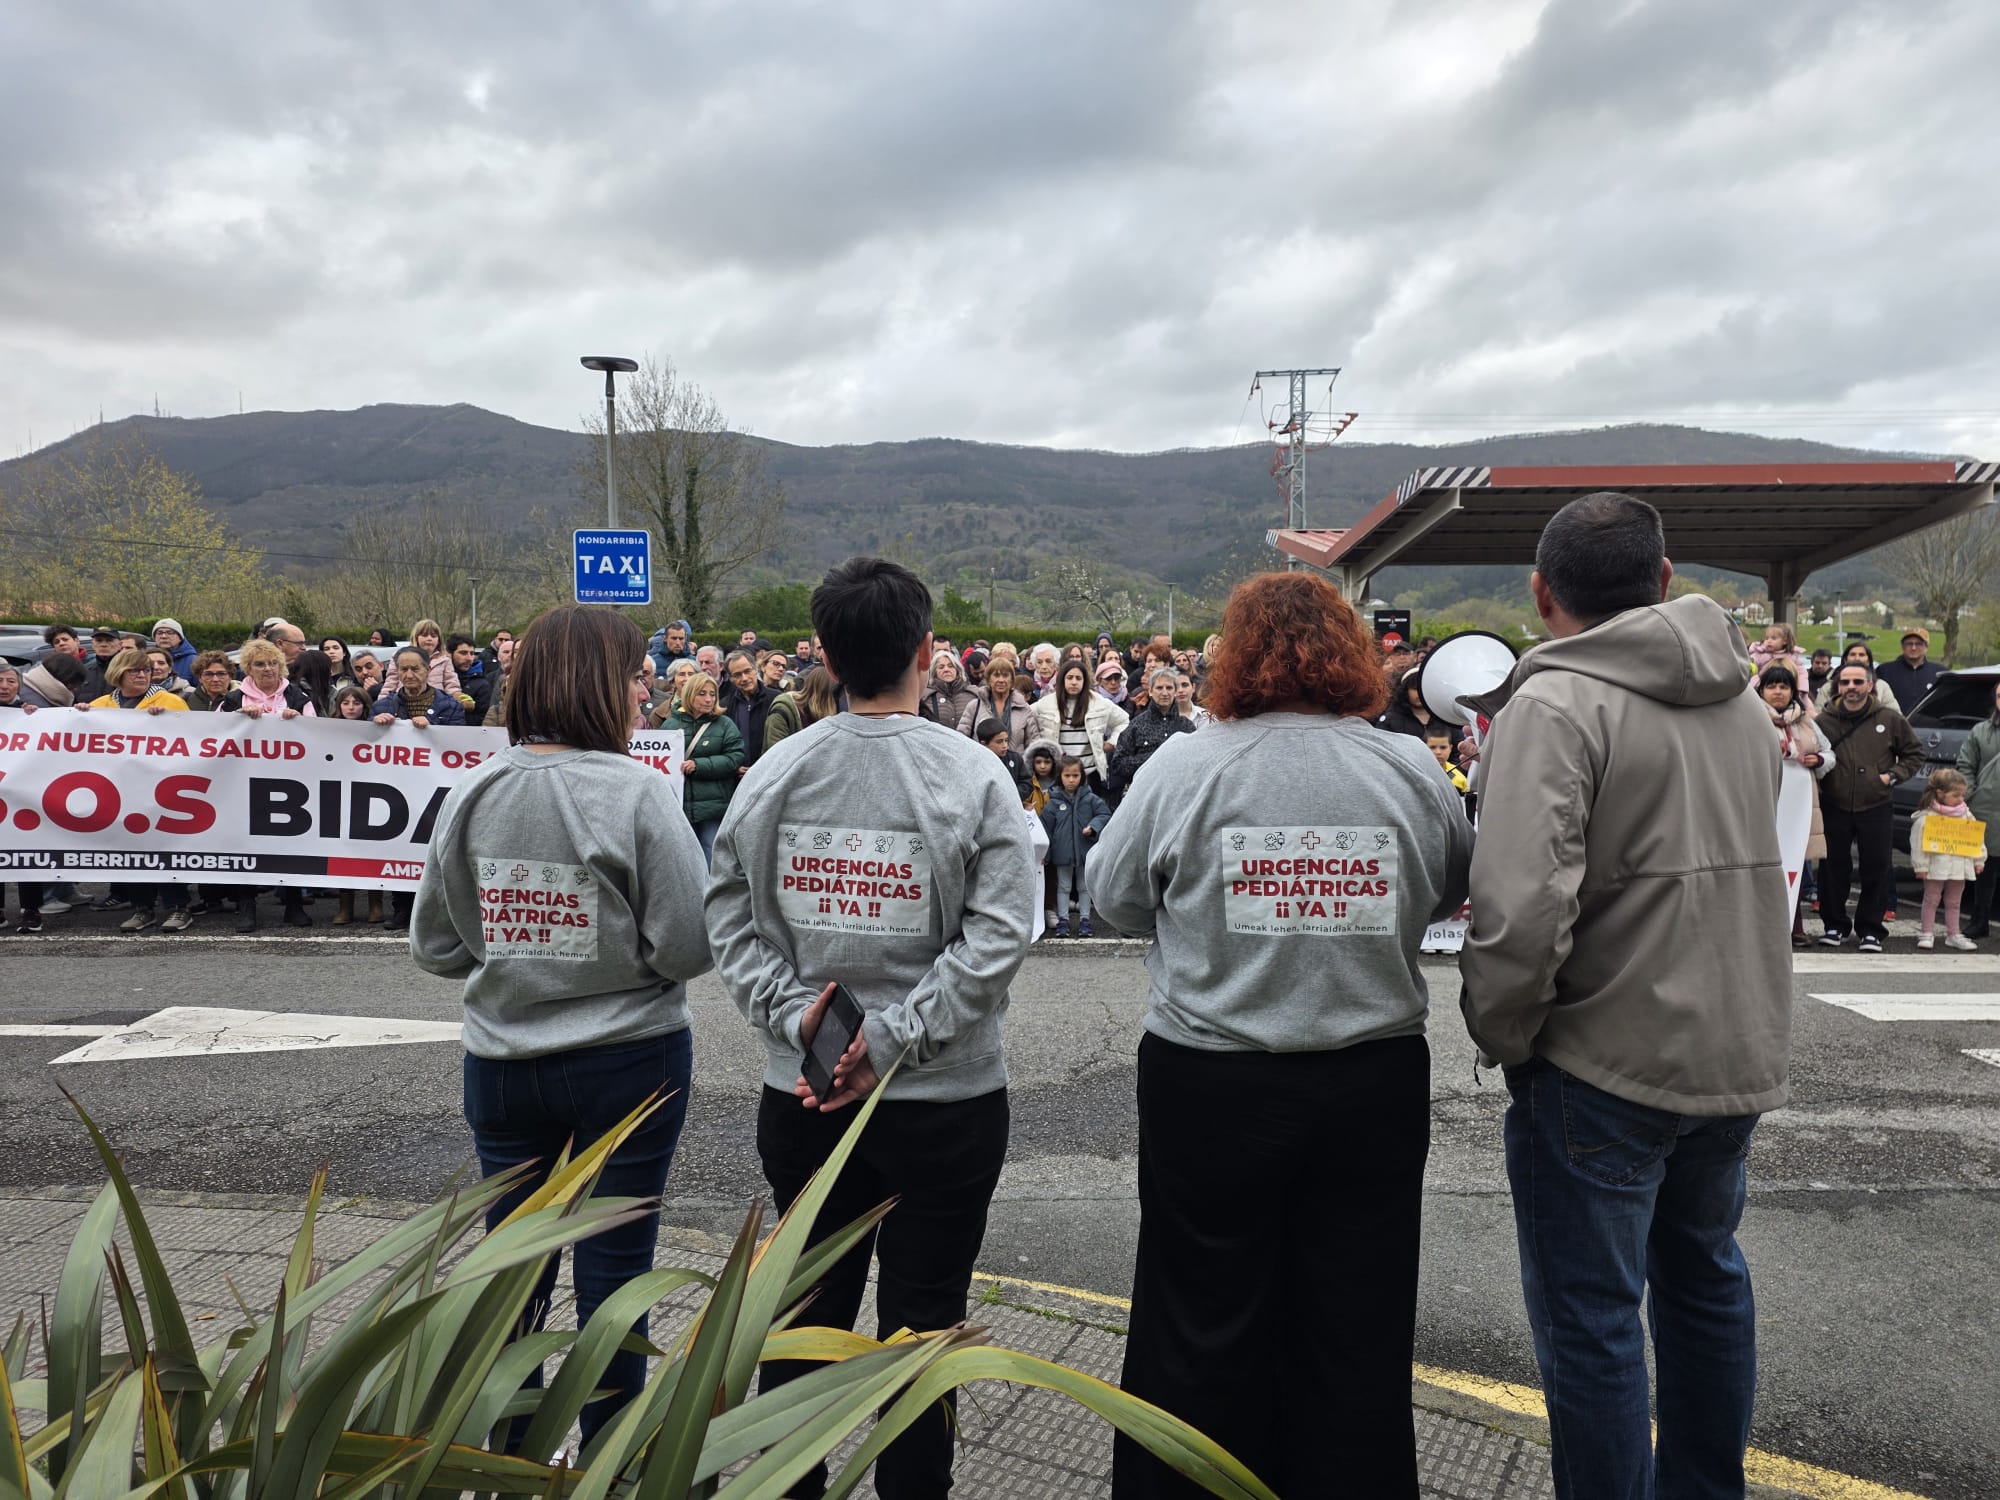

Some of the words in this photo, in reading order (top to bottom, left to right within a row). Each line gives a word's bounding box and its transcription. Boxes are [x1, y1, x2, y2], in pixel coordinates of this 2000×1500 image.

[578, 536, 645, 545] HONDARRIBIA
[579, 555, 644, 574] TAXI
[37, 732, 190, 757] NUESTRA
[199, 737, 306, 761] SALUD
[352, 743, 431, 767] GURE
[441, 750, 496, 769] OS
[0, 770, 216, 834] .O.S
[64, 853, 165, 870] BERRITU,
[171, 854, 257, 870] HOBETU
[791, 856, 913, 880] URGENCIAS
[1241, 858, 1379, 876] URGENCIAS
[783, 875, 922, 900] PEDIÁTRICAS
[1232, 876, 1388, 897] PEDIÁTRICAS
[478, 887, 579, 909] RGENCIAS
[837, 898, 861, 917] YA
[868, 902, 881, 918] !!
[1295, 901, 1327, 918] YA
[1333, 901, 1347, 918] !!
[501, 927, 532, 943] YA
[538, 928, 551, 944] !!
[813, 919, 840, 929] lehen,
[842, 922, 886, 932] larrialdiak
[889, 926, 921, 934] hemen
[1234, 923, 1267, 932] Umeak
[1270, 923, 1300, 933] lehen,
[1302, 923, 1352, 933] larrialdiak
[1354, 924, 1388, 932] hemen
[1428, 929, 1464, 941] jolas
[559, 950, 590, 959] hemen
